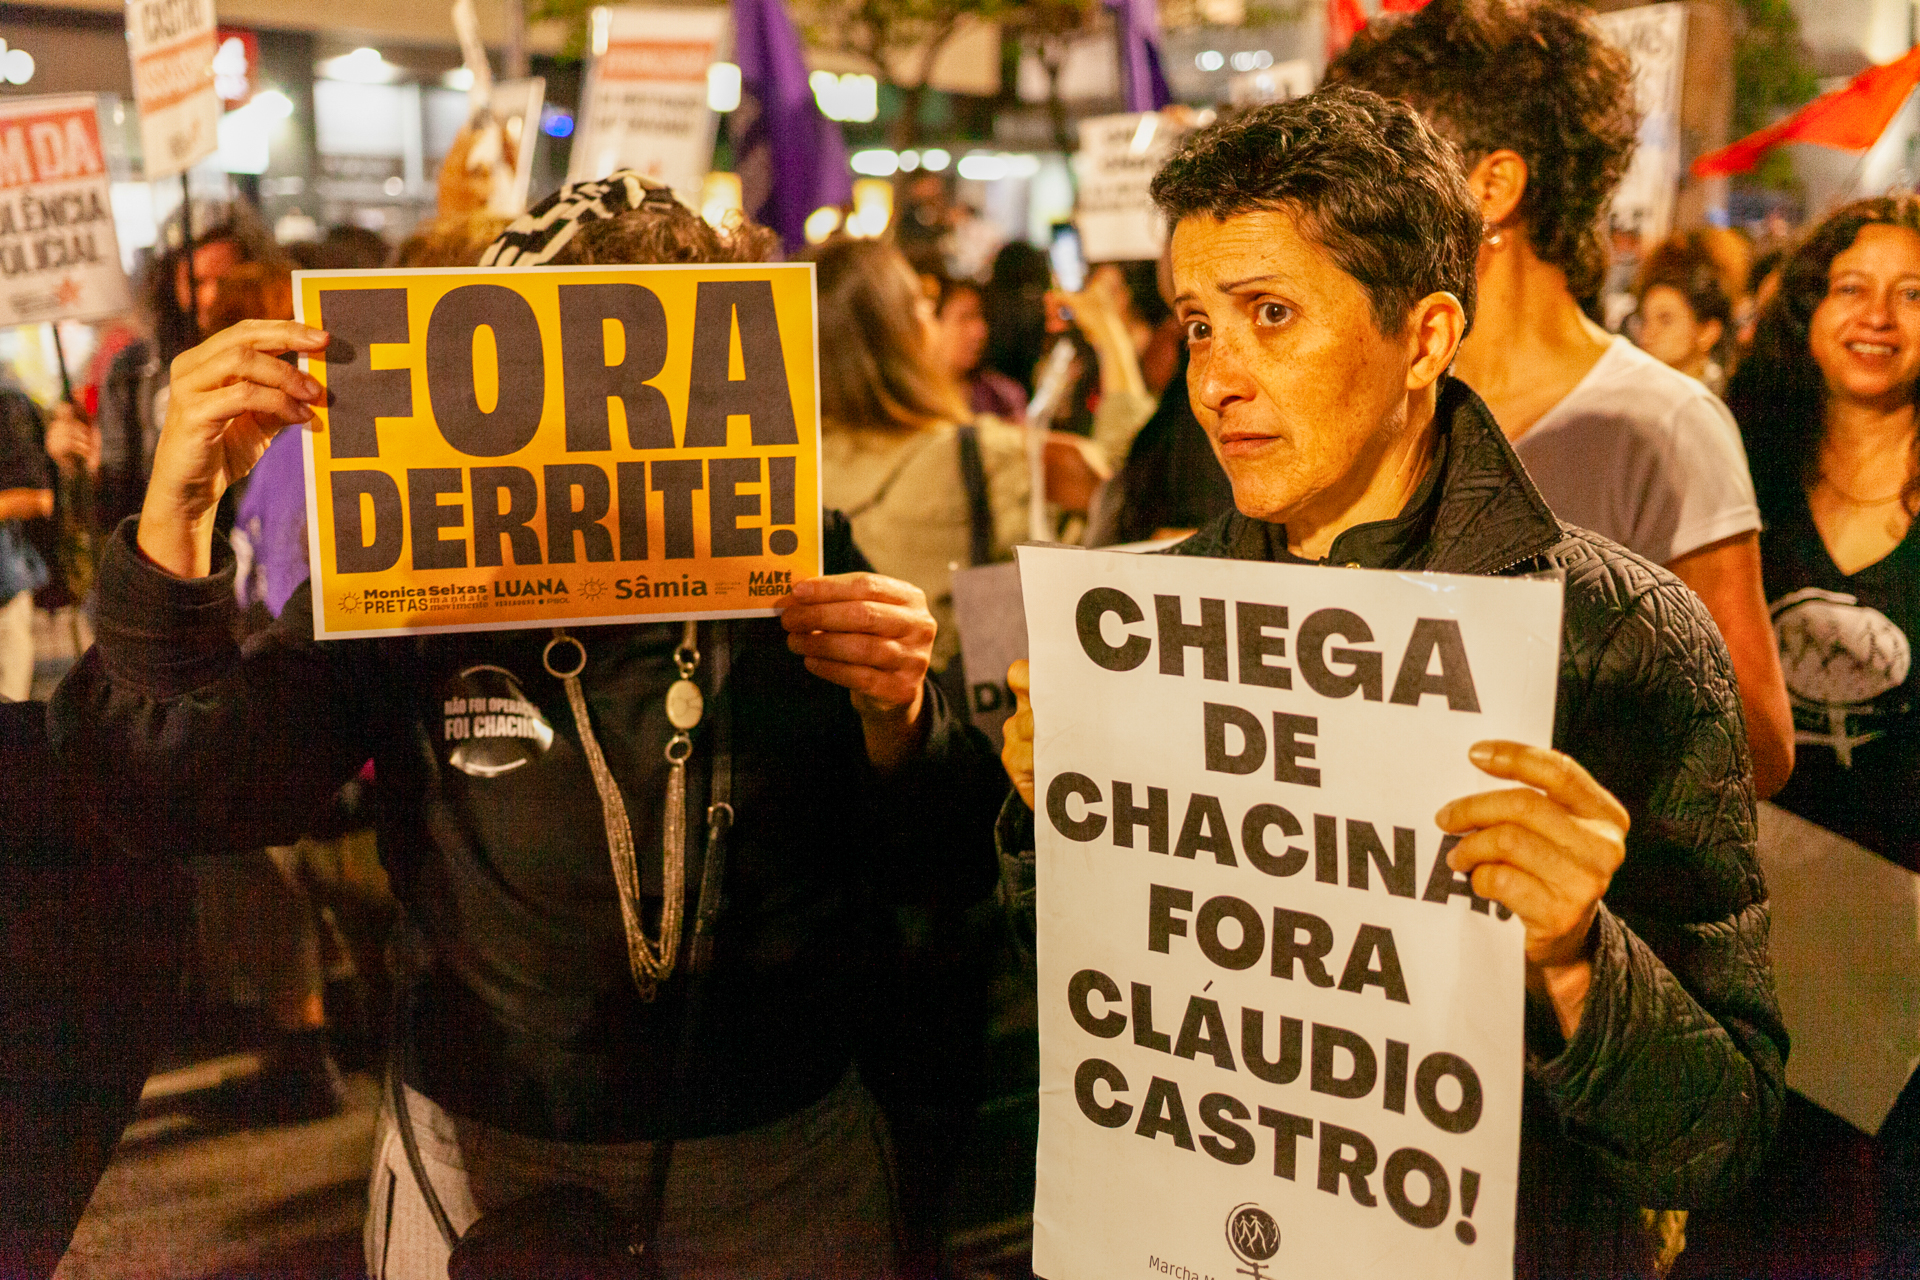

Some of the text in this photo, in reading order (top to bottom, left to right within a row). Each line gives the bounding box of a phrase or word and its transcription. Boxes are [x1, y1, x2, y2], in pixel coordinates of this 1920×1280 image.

[30, 116, 102, 178] DA
[319, 280, 800, 459] FORA
[330, 456, 799, 574] DERRITE!
[364, 583, 487, 600] Monica Seixas
[365, 599, 428, 614] PRETAS
[494, 578, 569, 598] LUANA
[615, 574, 708, 600] Sâmia
[749, 584, 793, 597] NEGRA
[1075, 587, 1482, 714] CHEGA
[445, 715, 541, 740] FOI CHACIN
[469, 698, 487, 713] FOI
[1203, 701, 1322, 788] DE
[1148, 883, 1411, 1005] FORA
[1067, 968, 1483, 1134] CLÁUDIO
[1074, 1057, 1481, 1246] CASTRO!
[1149, 1255, 1199, 1280] Marcha
